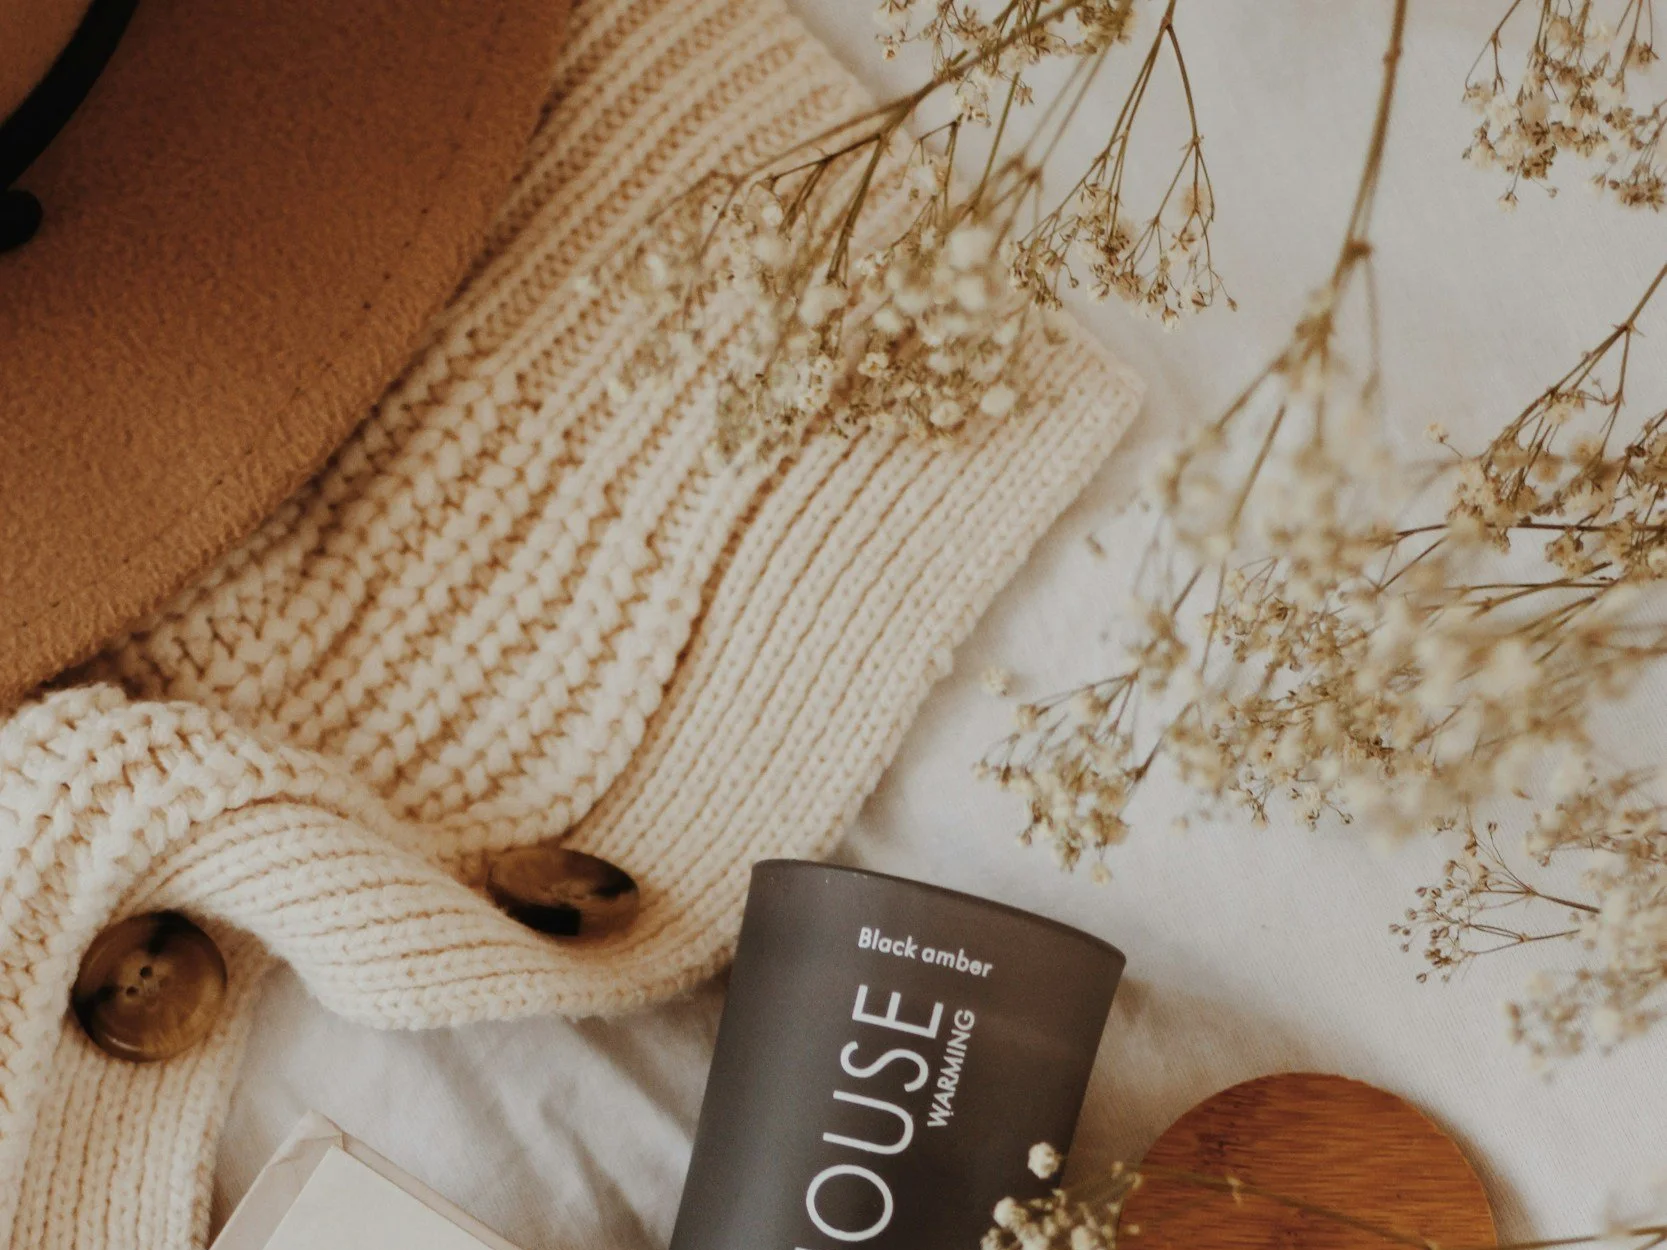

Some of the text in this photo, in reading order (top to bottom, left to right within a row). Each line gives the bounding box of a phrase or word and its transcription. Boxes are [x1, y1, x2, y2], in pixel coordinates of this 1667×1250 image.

[857, 926, 993, 979] Black amber
[927, 1008, 976, 1128] WARMING
